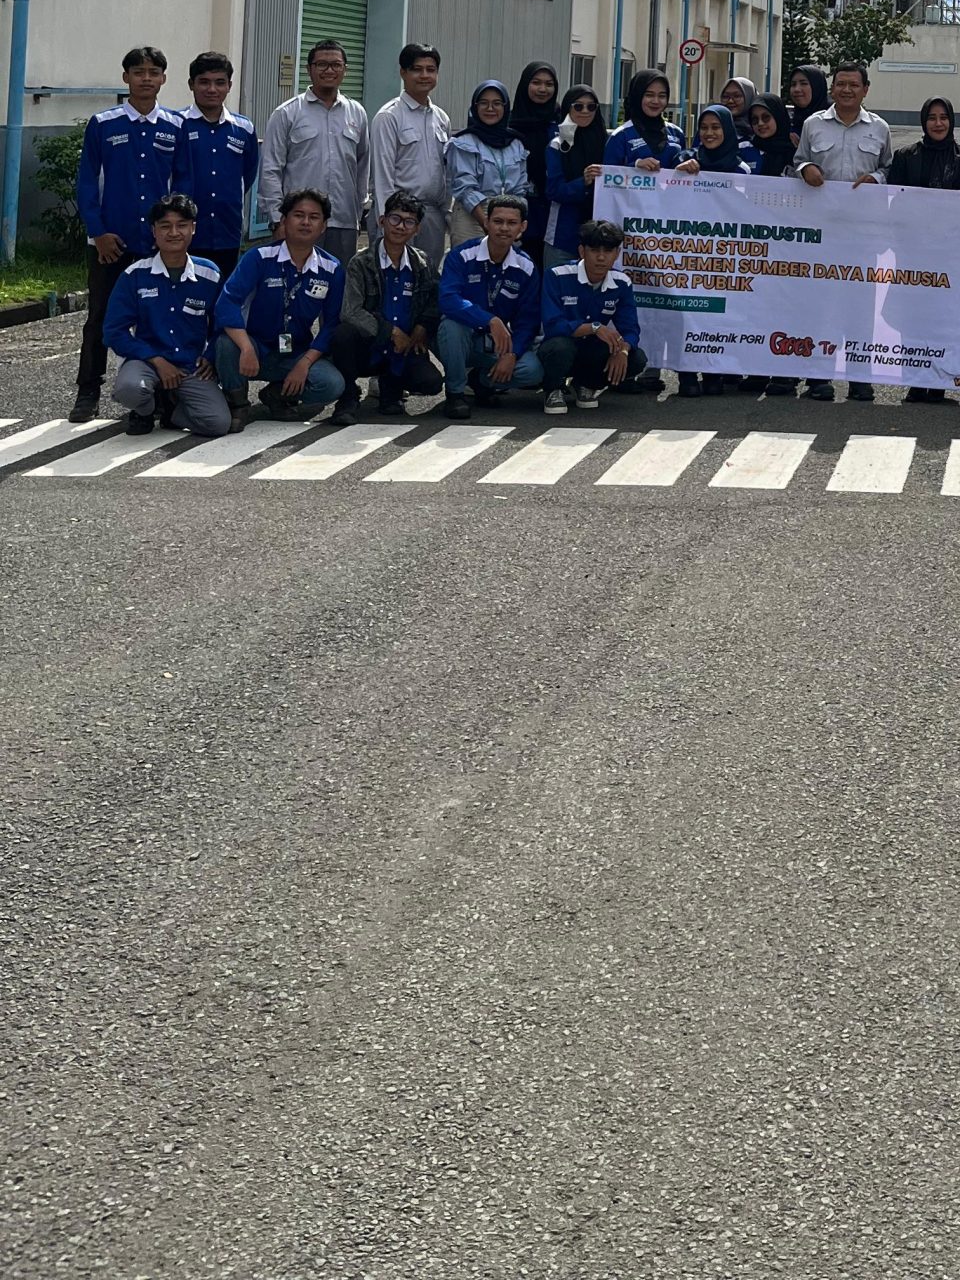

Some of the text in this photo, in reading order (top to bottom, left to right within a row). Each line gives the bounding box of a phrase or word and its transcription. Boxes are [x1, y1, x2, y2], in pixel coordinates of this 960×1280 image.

[684, 47, 696, 56] 20
[693, 180, 728, 188] CHEMICAL
[623, 217, 822, 243] KUNJUNGAN INDUSTRI
[623, 235, 769, 257] PROGRAM STUDI
[622, 252, 951, 288] MANAJEMEN SUMBER DAYA MANUSIA
[691, 274, 754, 292] PUBLIK
[634, 294, 710, 309] lasa, 22 April 2025
[685, 332, 765, 345] Politeknik PGRI
[684, 343, 725, 355] Banten
[845, 341, 945, 359] PT. Lotte Chemical
[845, 352, 932, 369] Titan Nusantara
